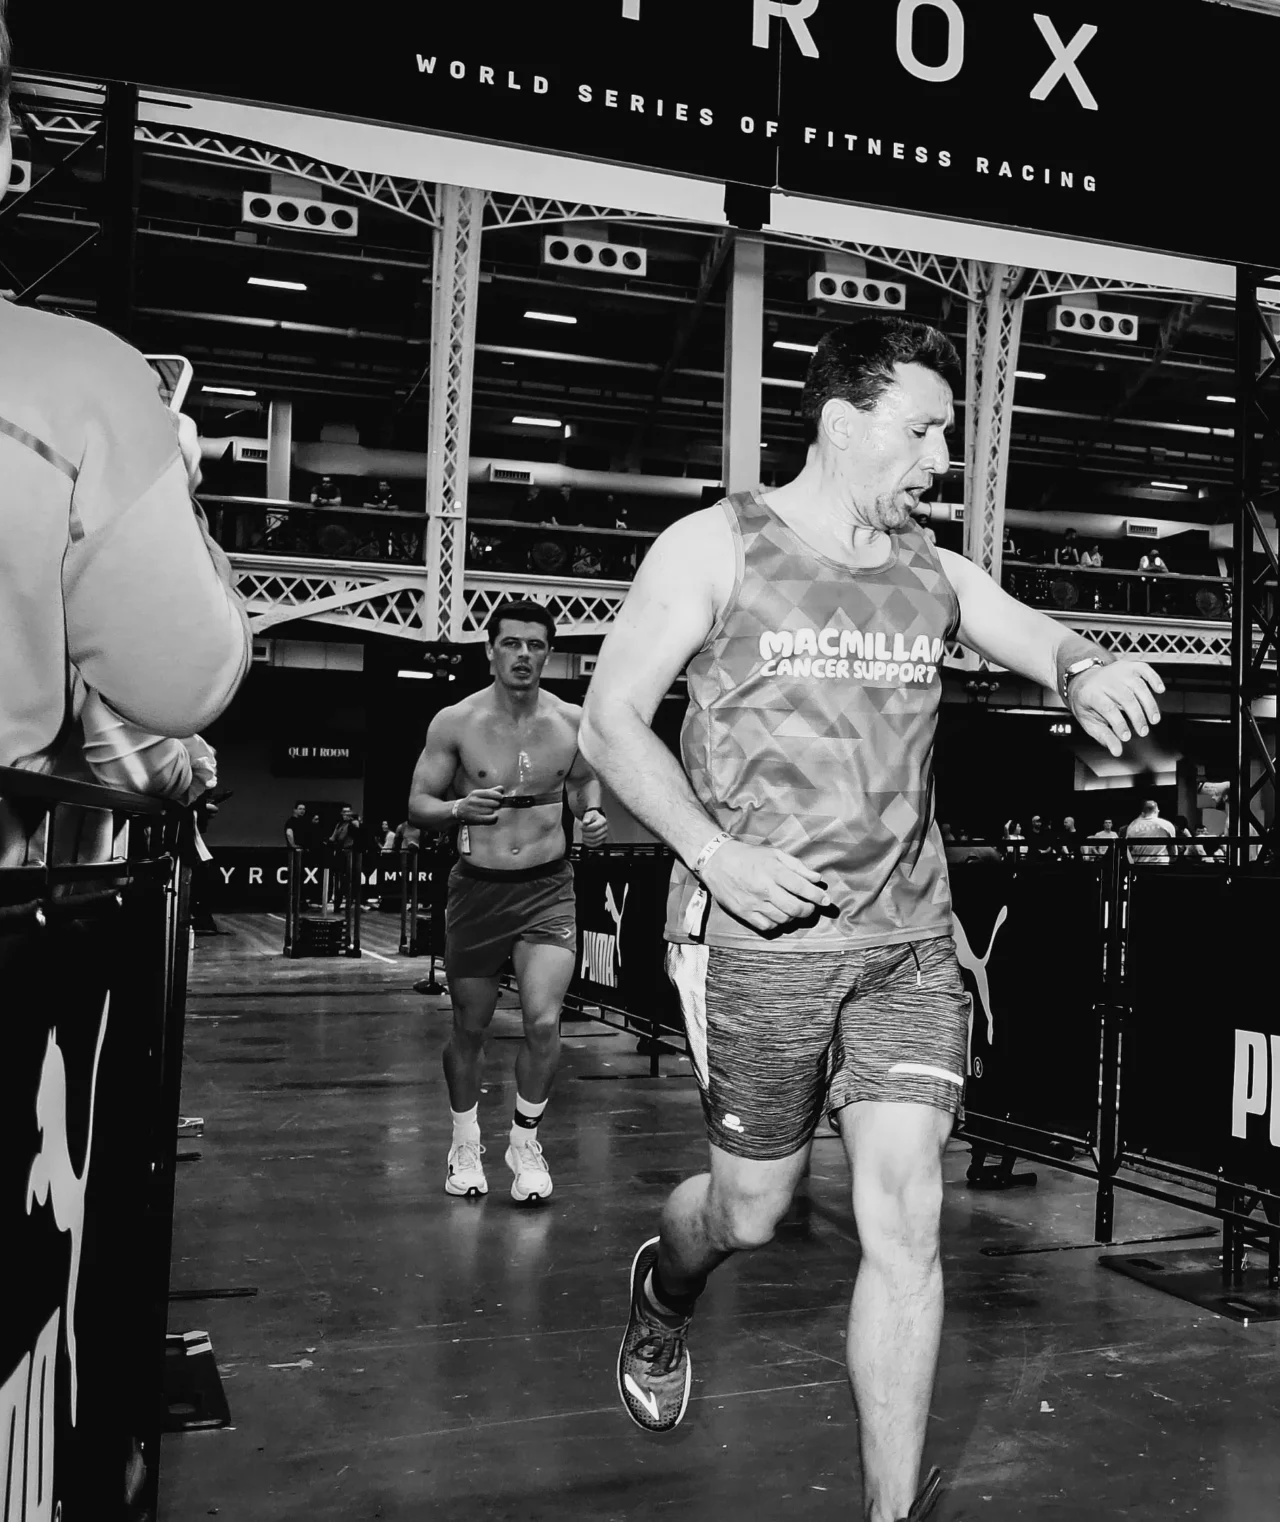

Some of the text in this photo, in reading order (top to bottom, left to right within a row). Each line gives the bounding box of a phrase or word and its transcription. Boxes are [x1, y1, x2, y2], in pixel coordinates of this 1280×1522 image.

[622, 0, 1098, 110] ROX
[416, 53, 1096, 191] WORLD SERIES OF FITNESS RACING
[759, 628, 944, 662] MACMILLAN
[760, 658, 936, 683] CANCER SUPPORT
[320, 748, 349, 757] ROOM
[581, 930, 615, 988] PUMA
